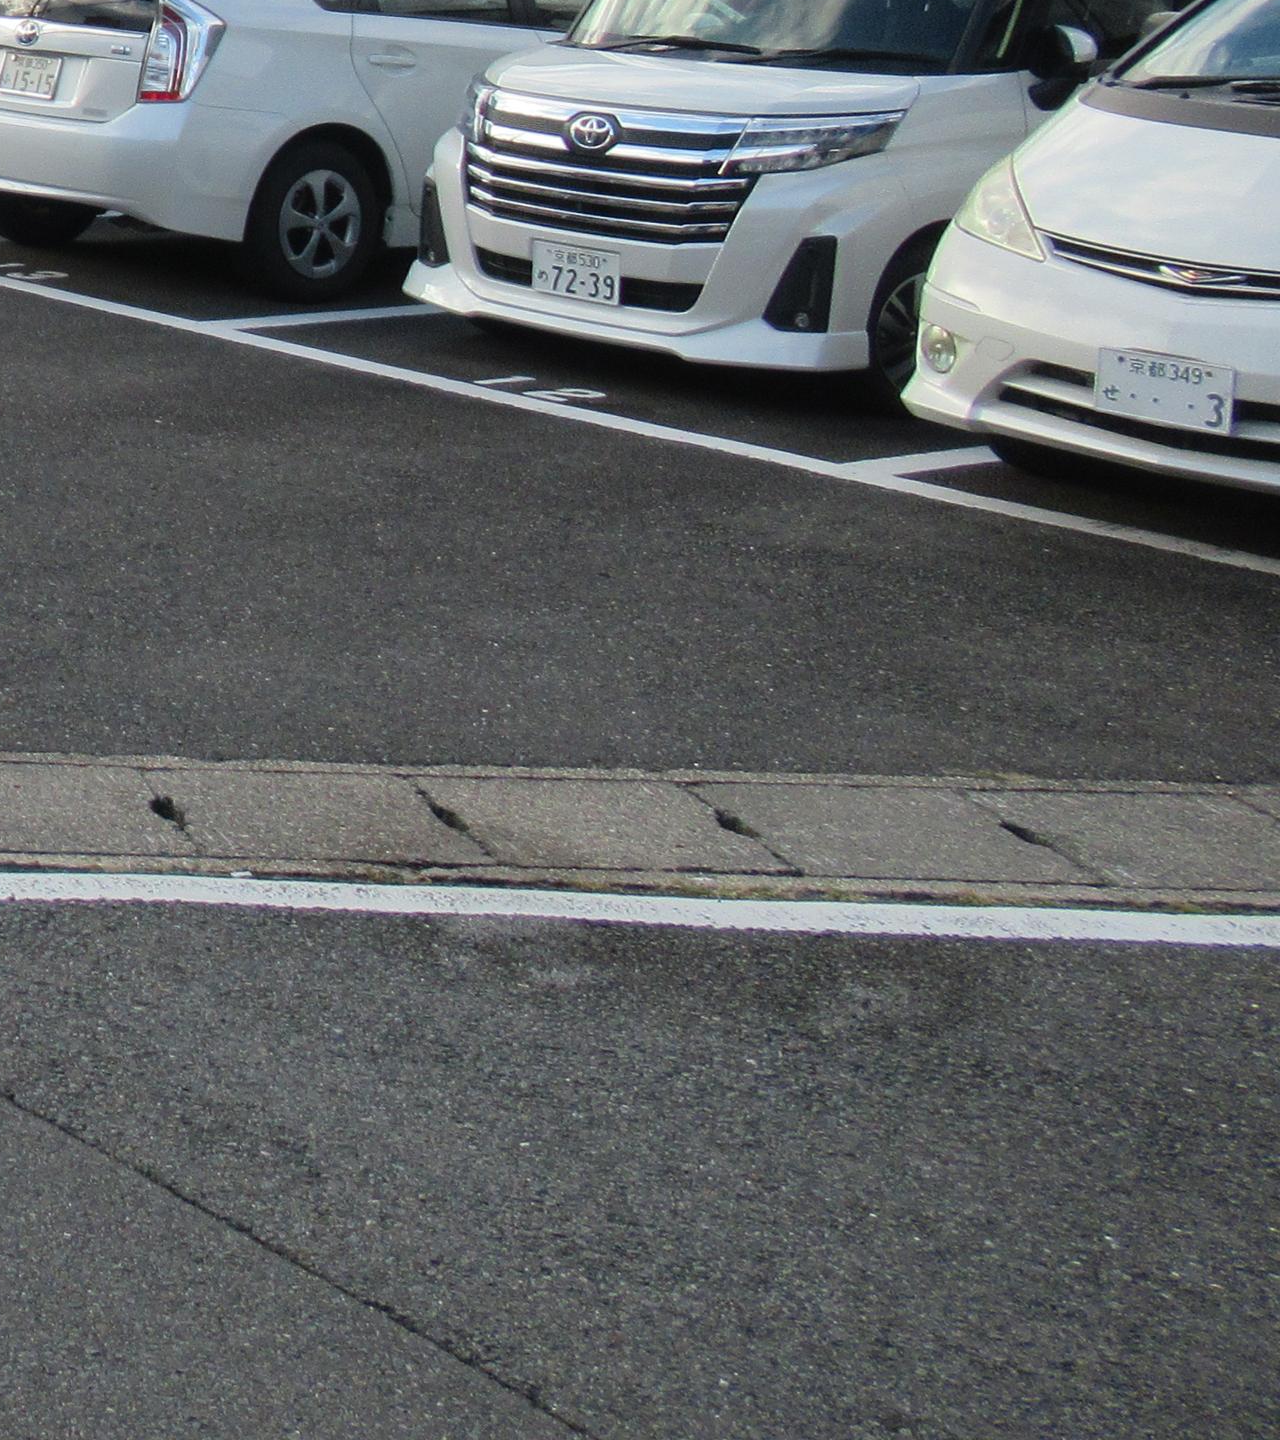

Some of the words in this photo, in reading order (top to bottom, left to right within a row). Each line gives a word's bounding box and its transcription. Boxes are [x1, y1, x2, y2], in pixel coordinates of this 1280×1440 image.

[12, 69, 55, 95] 15-15
[554, 249, 600, 269] 京都530
[551, 265, 615, 300] 72-39
[1129, 358, 1203, 385] 京都349
